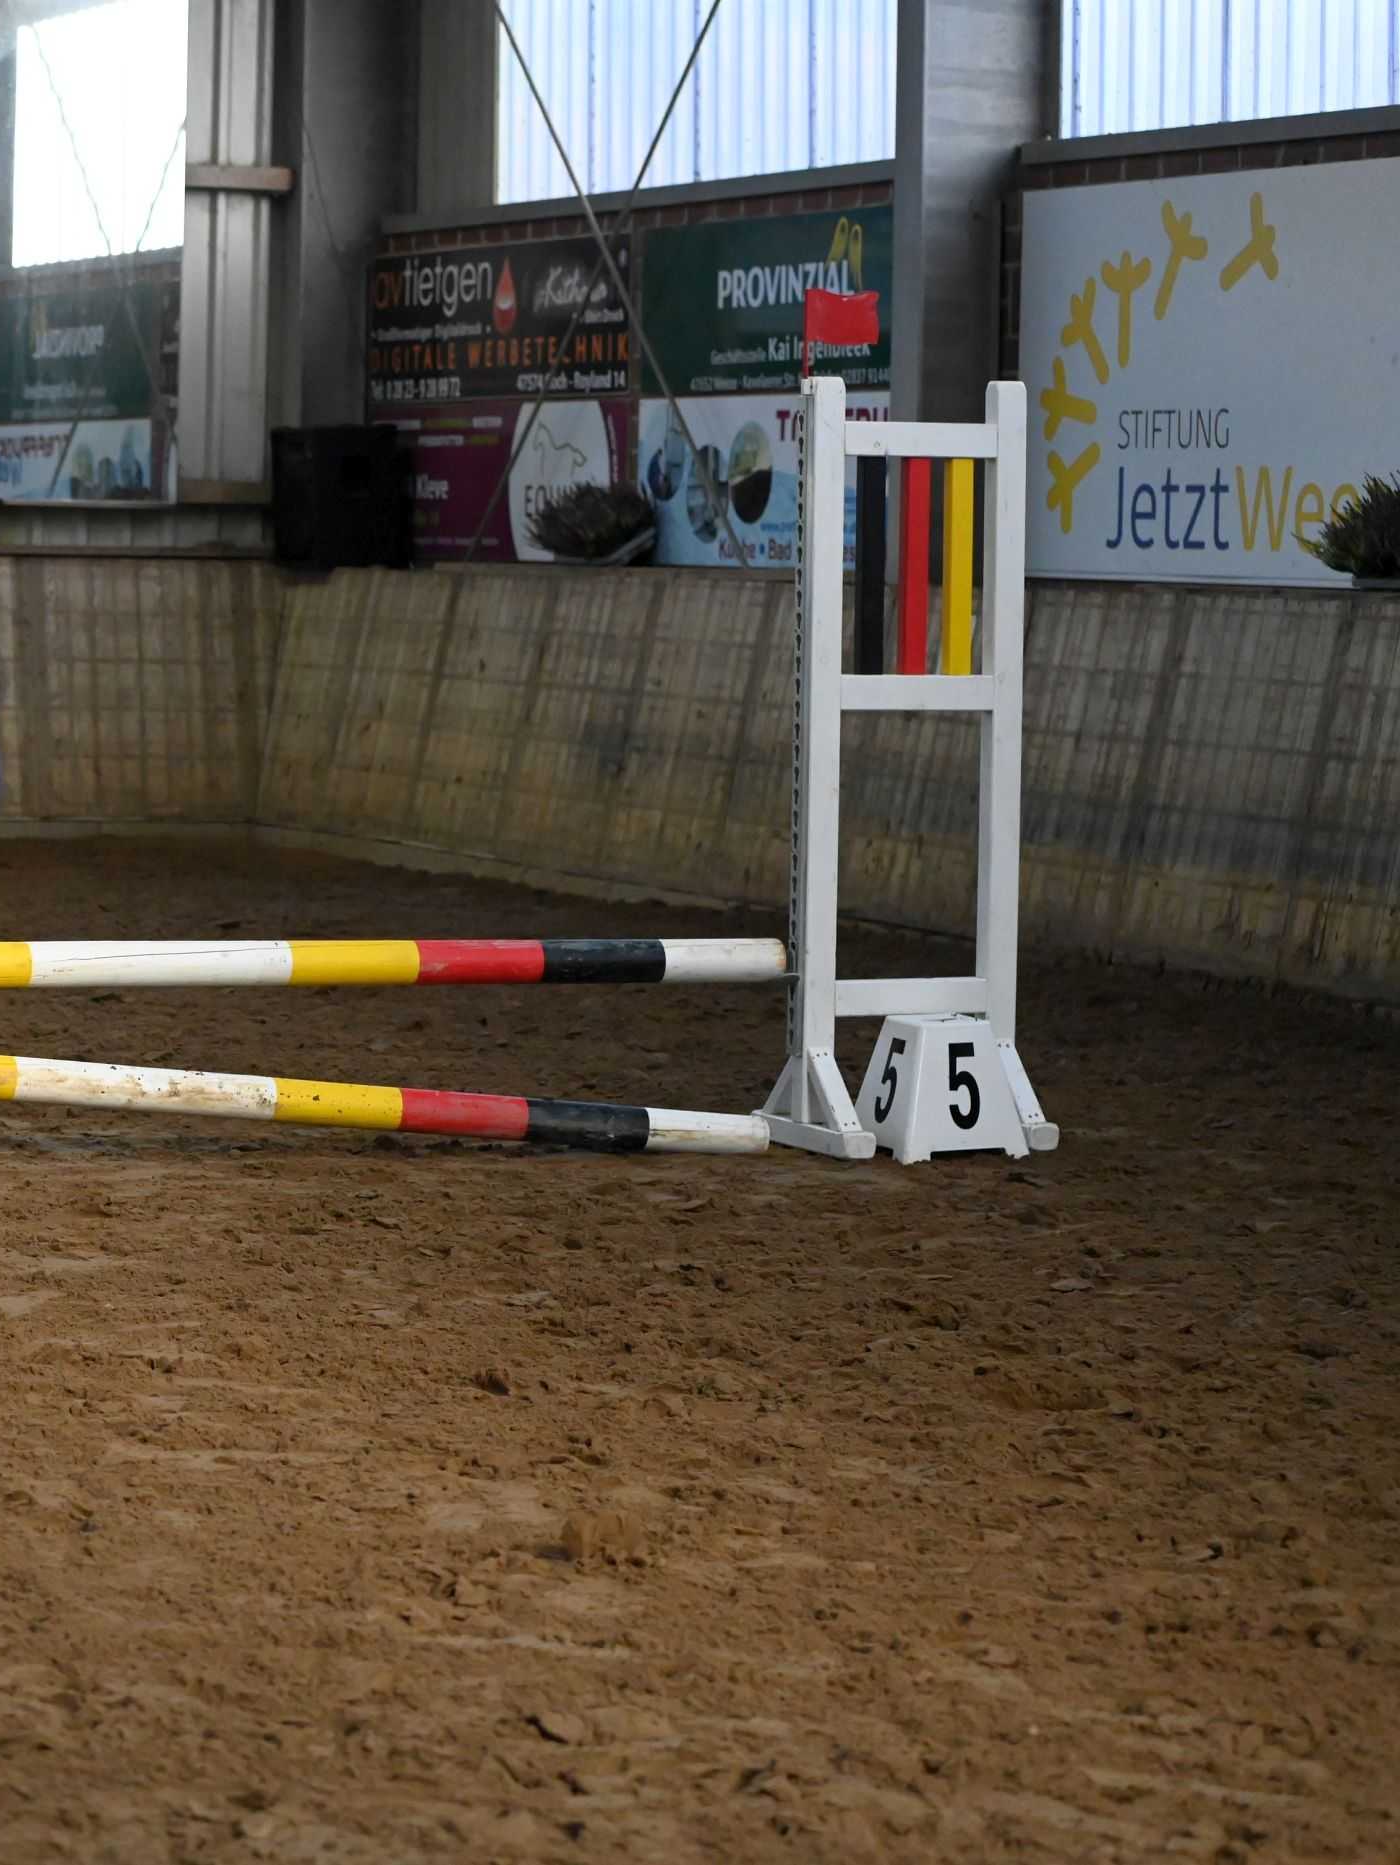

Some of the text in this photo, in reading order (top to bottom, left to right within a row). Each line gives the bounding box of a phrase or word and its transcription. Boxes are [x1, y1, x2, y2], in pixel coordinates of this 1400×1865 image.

[717, 259, 855, 310] PROVINZIAL
[768, 335, 790, 361] Kai
[1117, 408, 1230, 450] STIFTUNG
[874, 1037, 906, 1124] 5
[948, 1042, 981, 1130] 5
